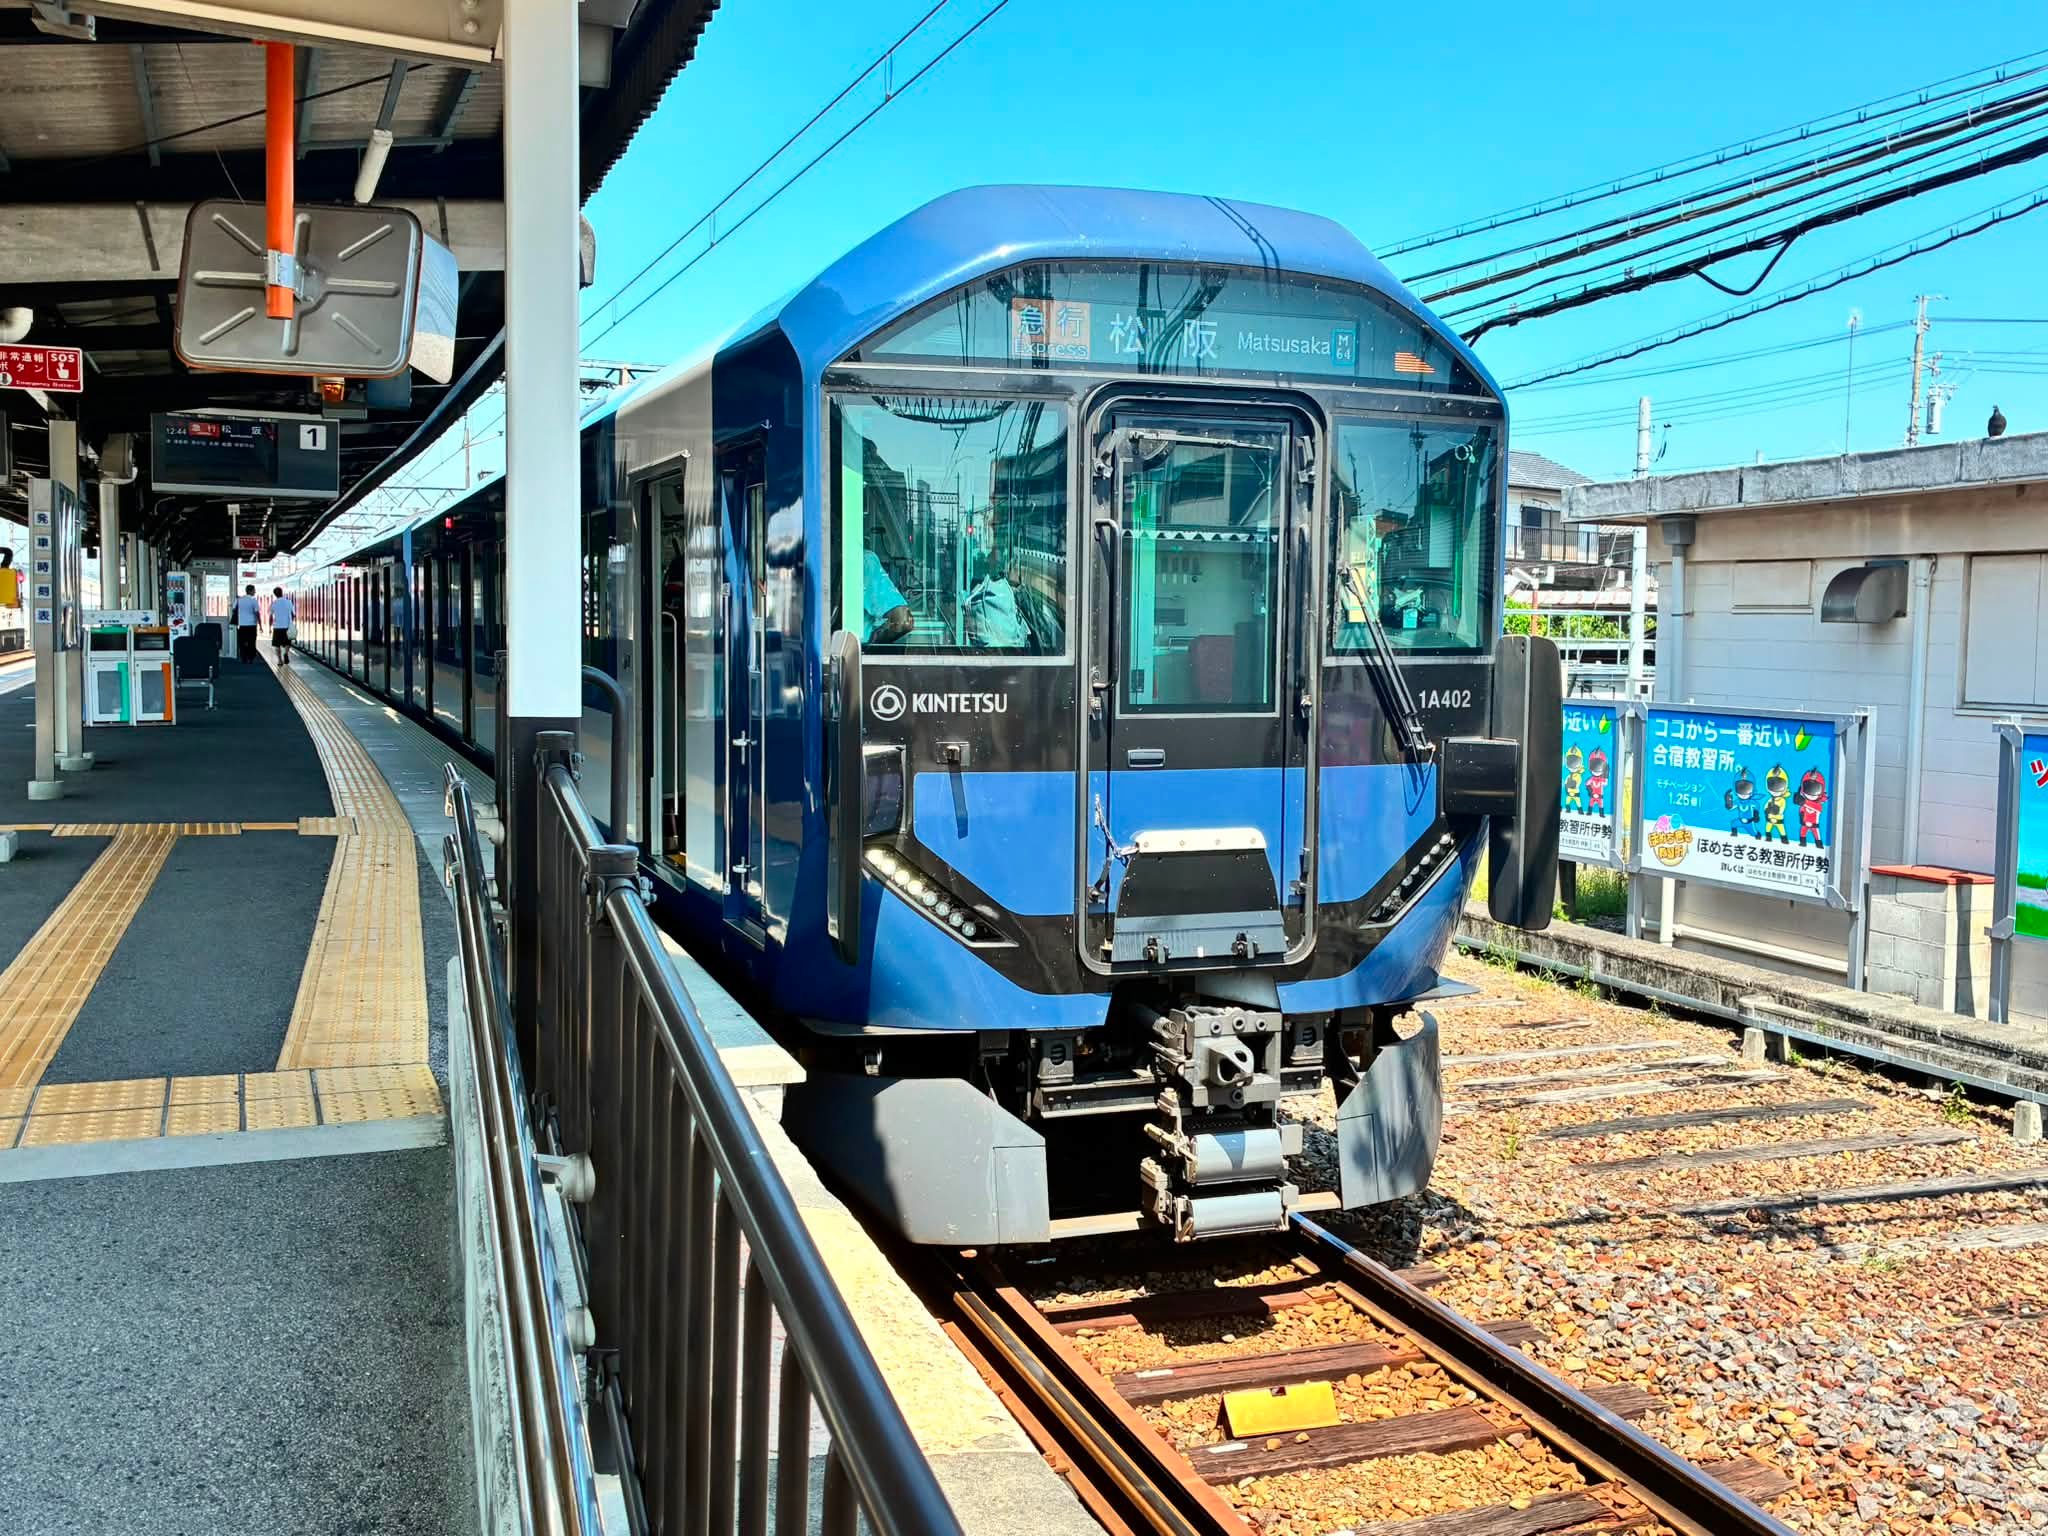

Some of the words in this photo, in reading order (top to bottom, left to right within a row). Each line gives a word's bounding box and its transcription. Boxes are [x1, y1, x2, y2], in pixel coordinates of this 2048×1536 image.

[1018, 303, 1084, 338] 急行
[1109, 312, 1217, 359] 松阪
[1238, 331, 1331, 355] Matsusaka
[1338, 334, 1349, 347] M
[1014, 337, 1088, 357] Express
[1336, 348, 1351, 360] 64
[50, 353, 75, 363] SOS
[306, 428, 318, 447] 1
[912, 693, 1008, 713] KINTETSU
[1419, 689, 1472, 709] 1A402
[1655, 718, 1791, 749] ココから一番近い
[1697, 838, 1830, 874] ほめちぎる教習所伊勢
